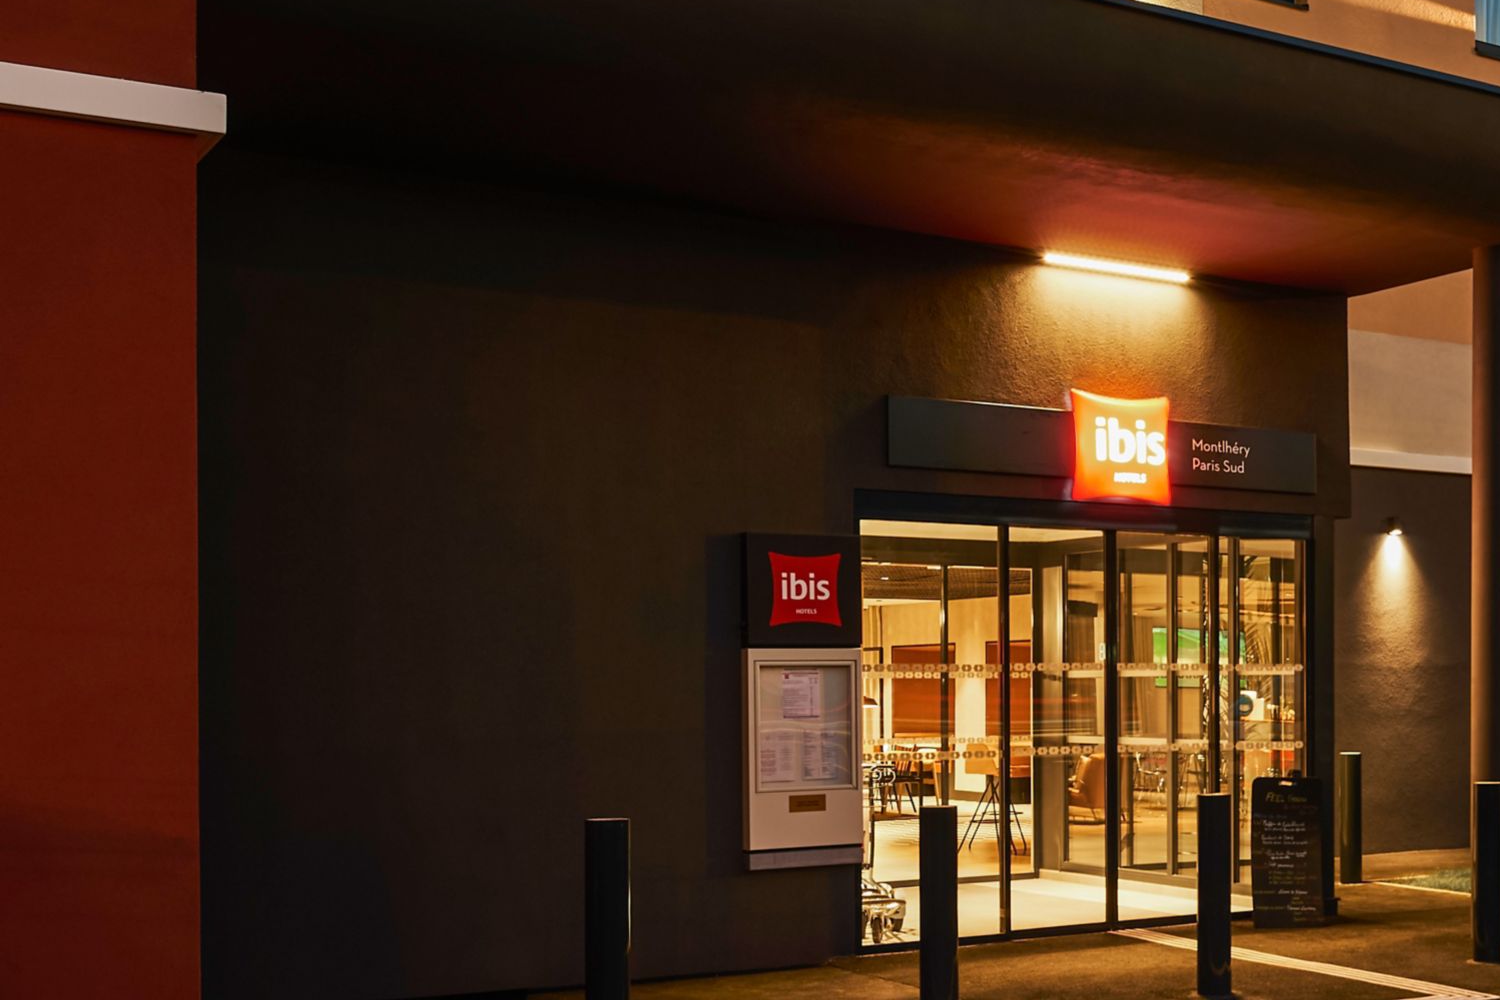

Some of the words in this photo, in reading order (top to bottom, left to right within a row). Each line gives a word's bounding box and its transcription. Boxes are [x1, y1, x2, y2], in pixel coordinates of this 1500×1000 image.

[1094, 415, 1167, 467] ibis
[1191, 438, 1250, 459] Montlhéry
[1192, 457, 1221, 472] Paris
[1223, 459, 1245, 473] Sud
[781, 572, 830, 601] ibis
[795, 607, 817, 615] HOTELS
